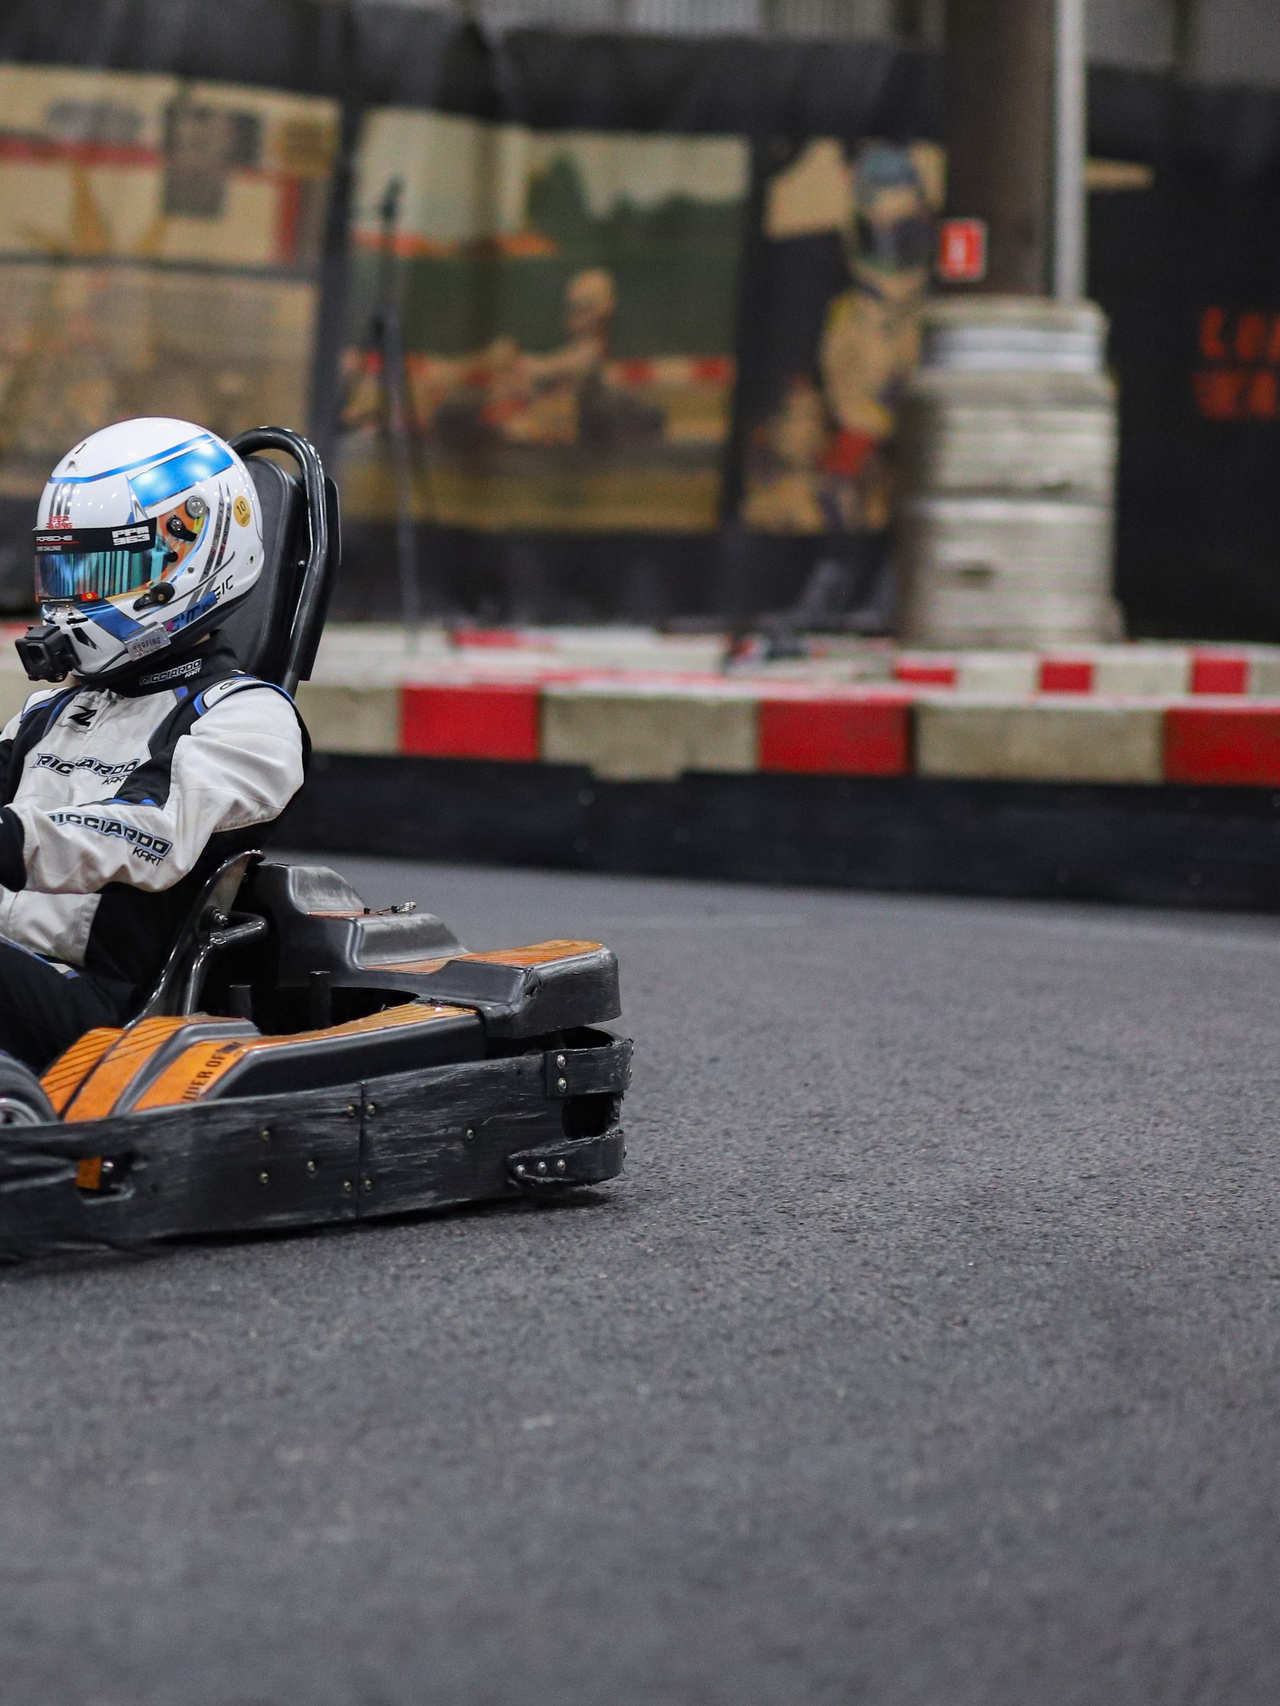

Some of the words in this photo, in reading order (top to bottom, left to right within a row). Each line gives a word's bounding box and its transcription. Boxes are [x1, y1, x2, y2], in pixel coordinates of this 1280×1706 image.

[236, 500, 247, 516] 10
[111, 526, 150, 539] PPM
[112, 533, 151, 546] 963
[140, 659, 202, 685] RICCIARDO
[36, 755, 139, 775] RICARDO
[132, 846, 163, 866] KART
